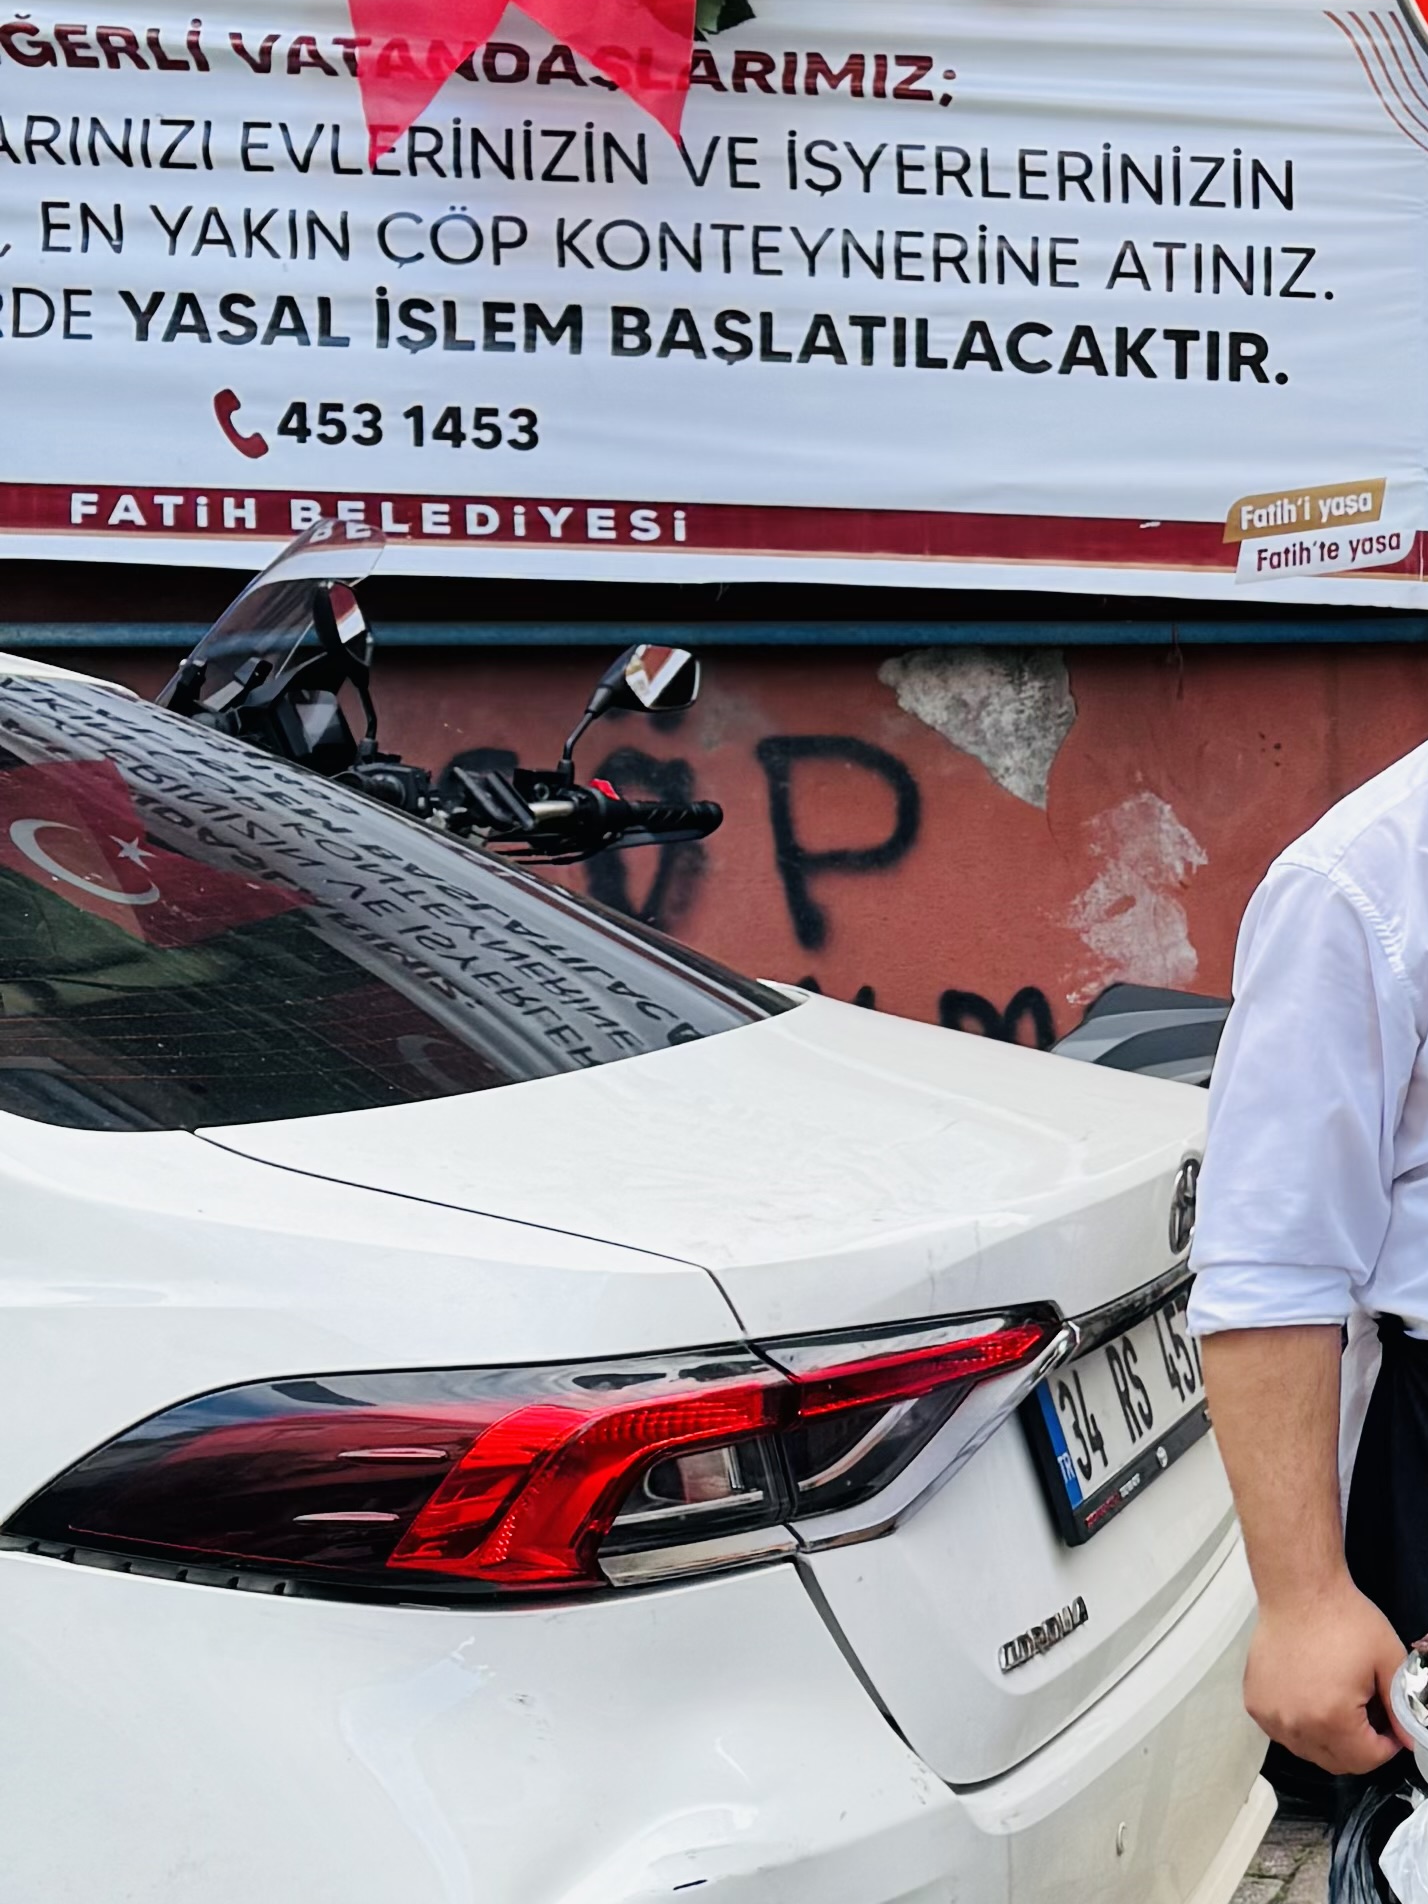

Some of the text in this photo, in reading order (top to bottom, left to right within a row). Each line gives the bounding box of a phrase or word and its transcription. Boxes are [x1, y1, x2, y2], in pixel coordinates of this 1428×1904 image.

[0, 13, 210, 72] ĞERLİ
[240, 117, 647, 184] EVLERİNİZİN
[679, 135, 761, 190] VE
[786, 129, 1294, 210] İŞYERLERİNİZİN
[41, 201, 1335, 301] EN YAKIN ÇÖP KONTEYNERİNE ATINIZ.
[0, 286, 1289, 385] DE YASAL İŞLEM BAŞLATILACAKTIR.
[277, 400, 540, 451] 453 1453
[1058, 1368, 1108, 1482] 34
[1106, 1335, 1154, 1444] RS
[1056, 1451, 1075, 1484] TR
